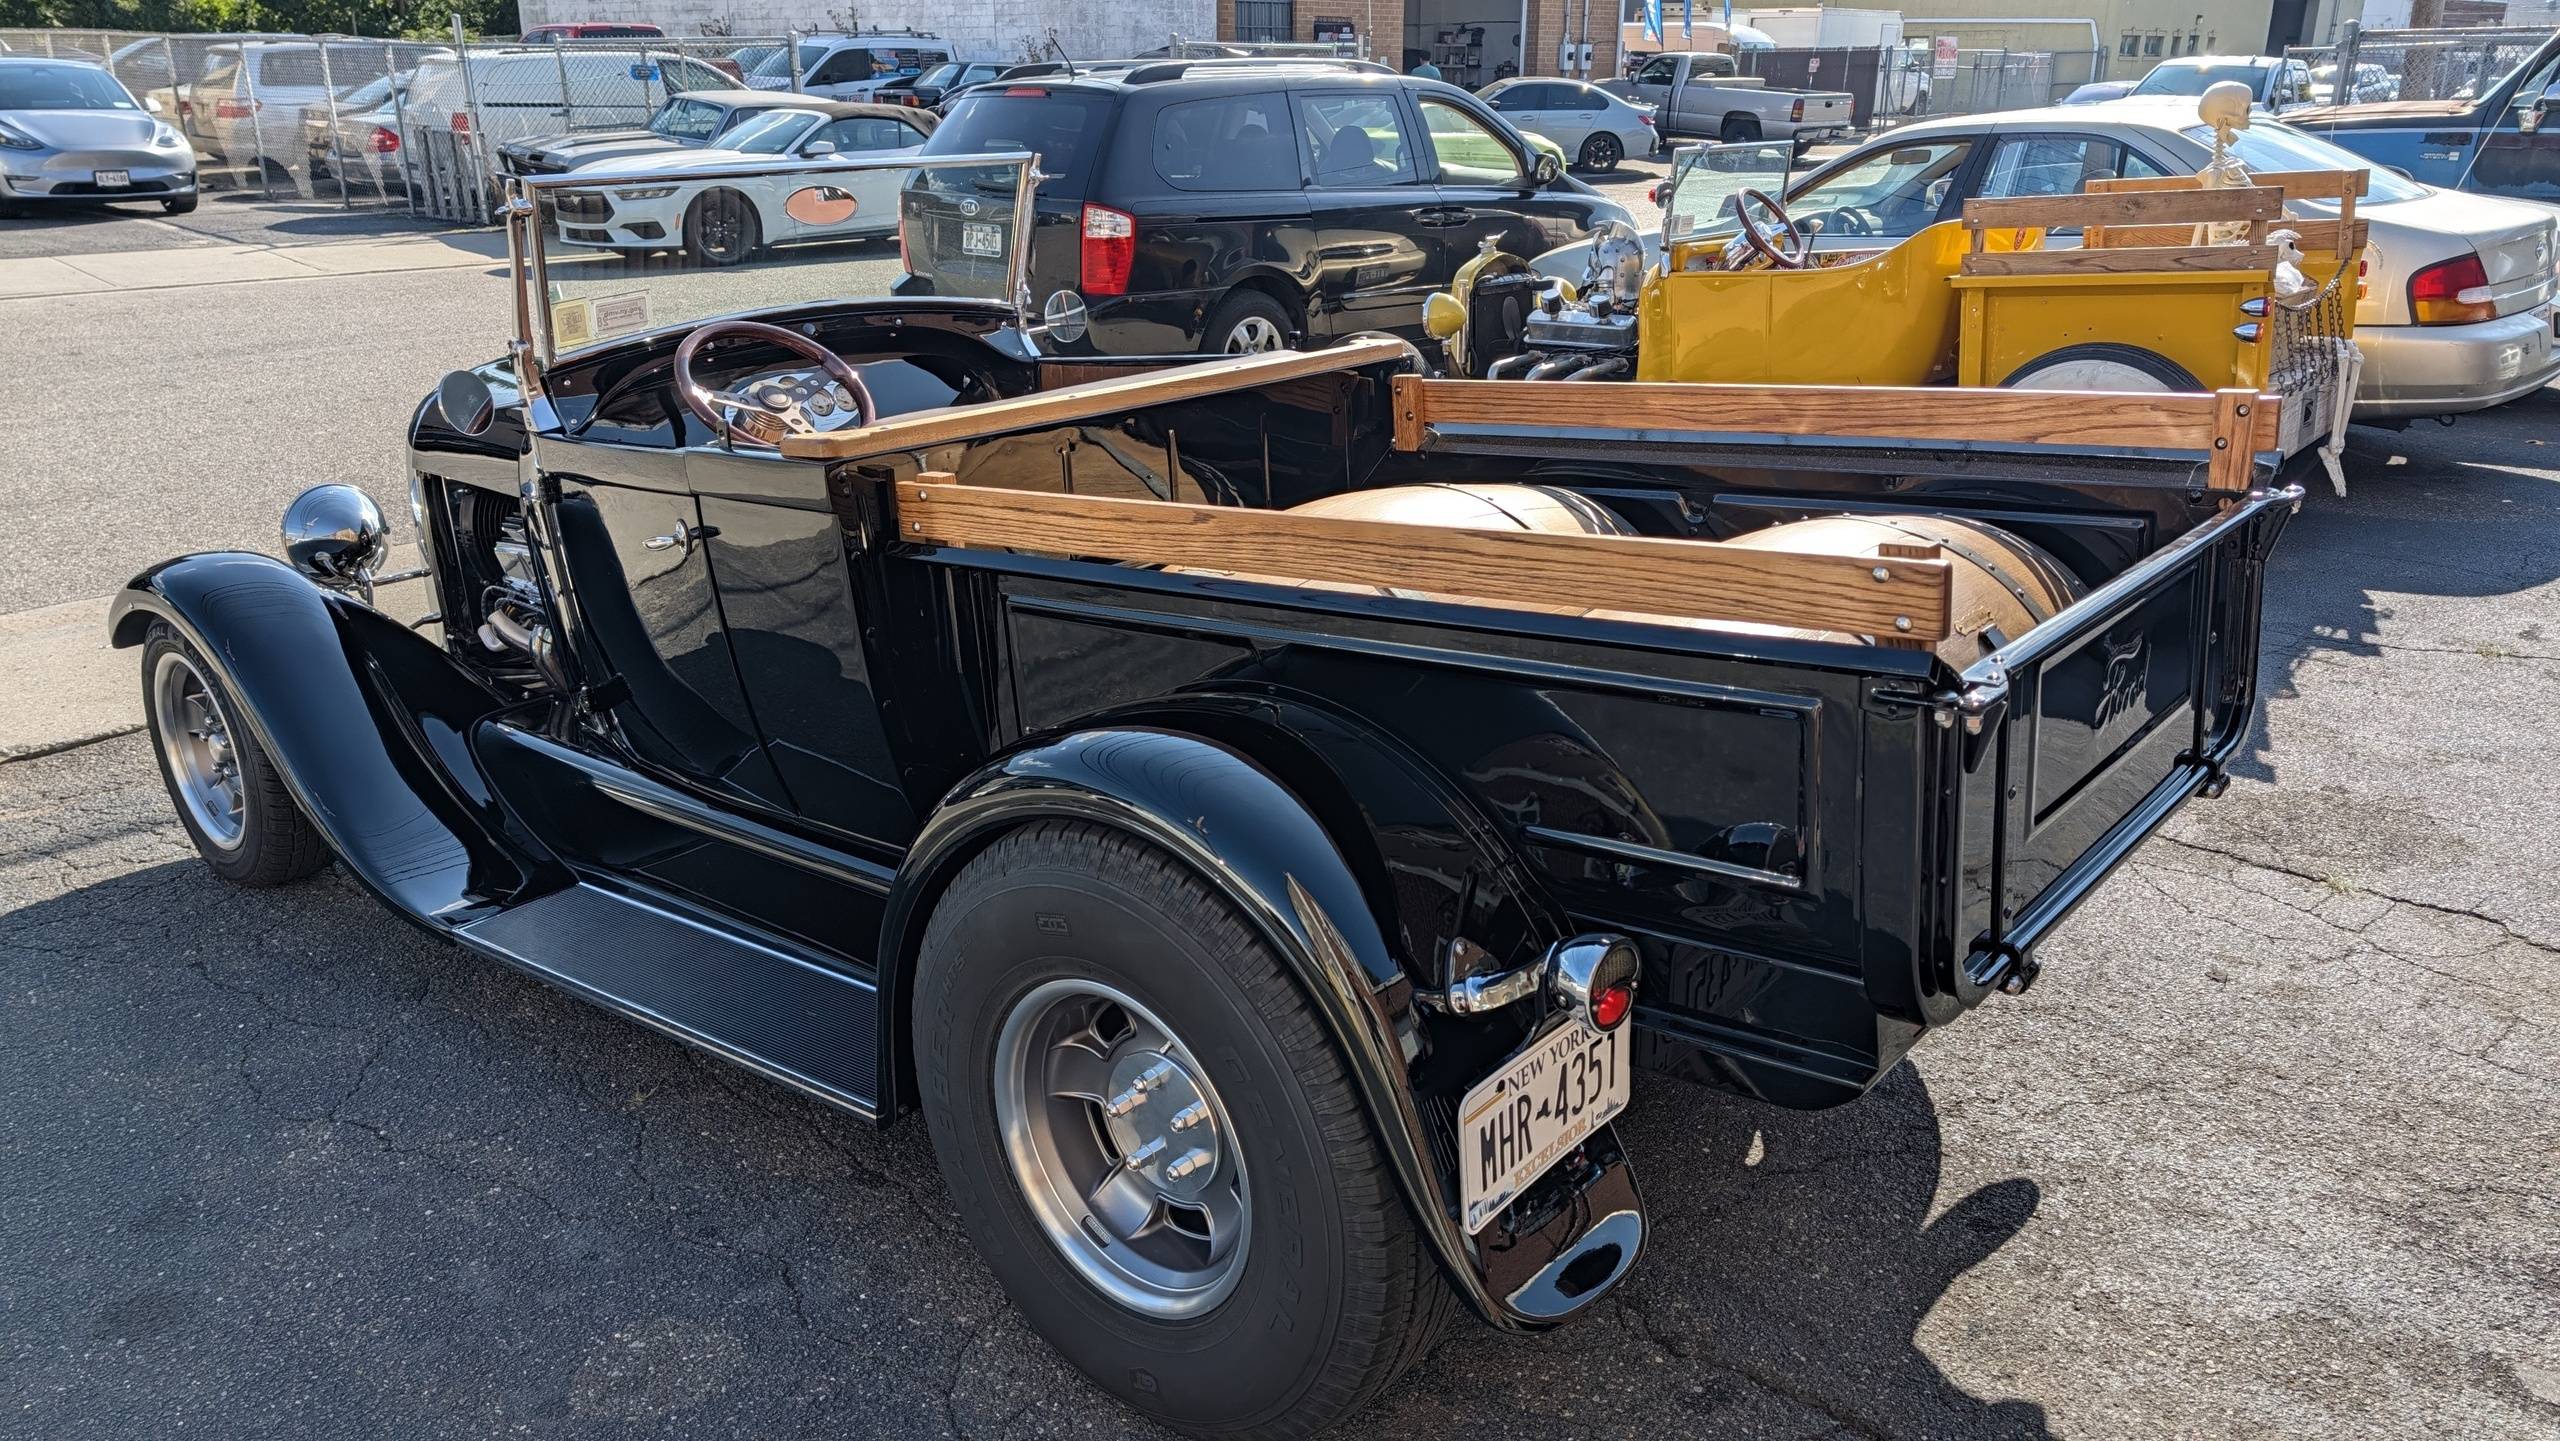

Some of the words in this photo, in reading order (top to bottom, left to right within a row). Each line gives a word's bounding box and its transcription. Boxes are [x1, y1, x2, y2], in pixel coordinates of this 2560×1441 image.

[963, 203, 976, 212] KIA
[2095, 632, 2151, 728] Ford
[1508, 1052, 1546, 1097] NEW
[1513, 1117, 1587, 1188] EXCELSIOR
